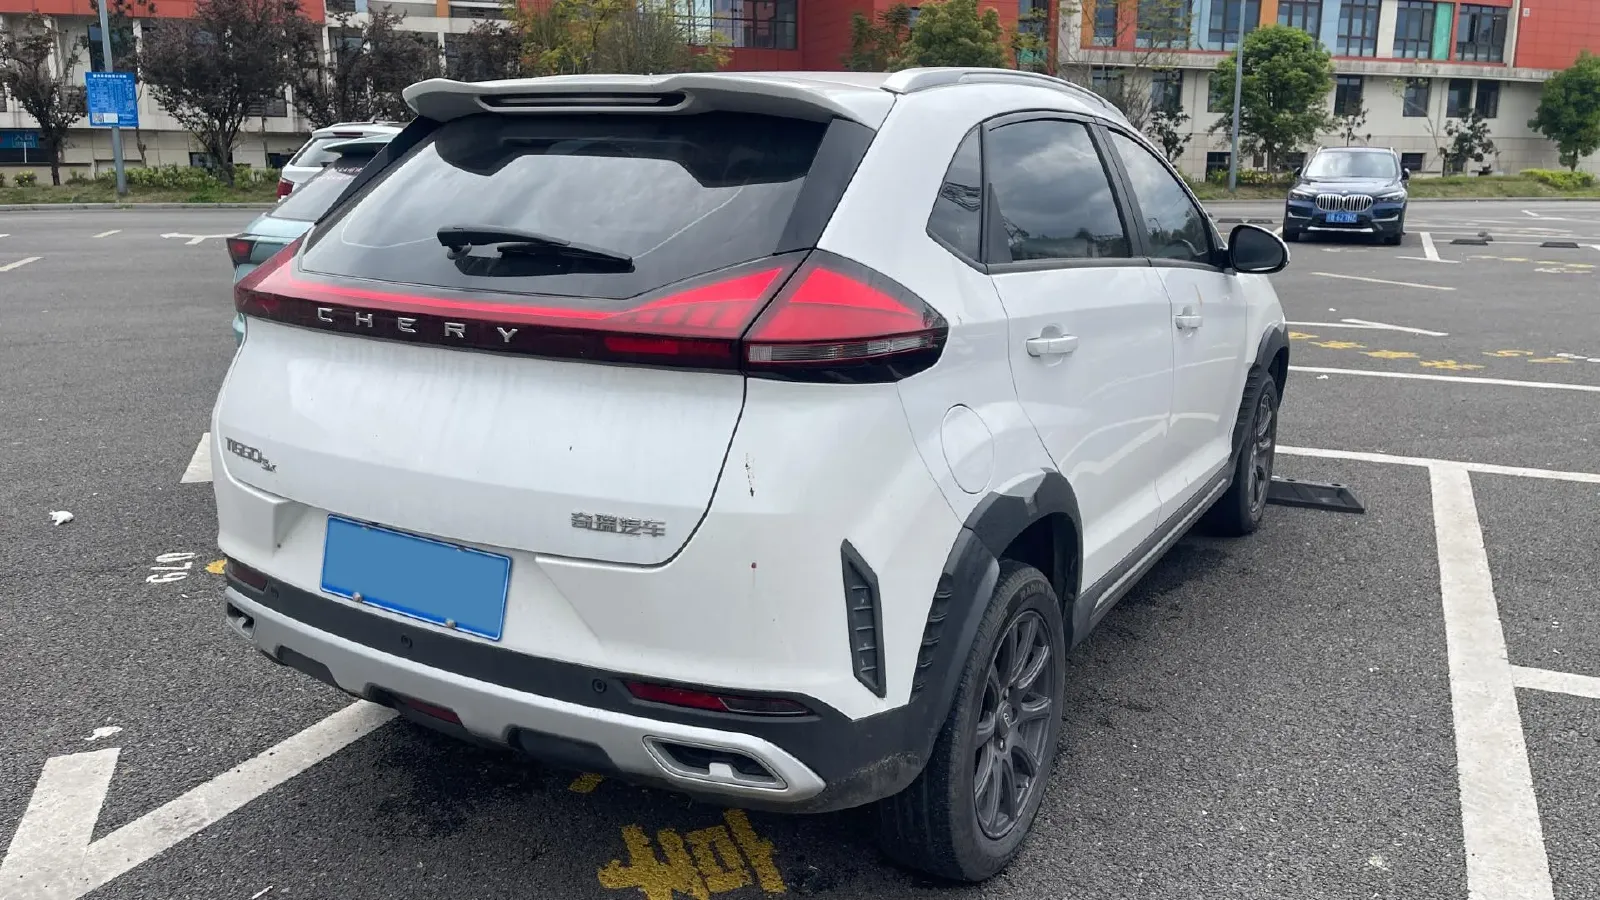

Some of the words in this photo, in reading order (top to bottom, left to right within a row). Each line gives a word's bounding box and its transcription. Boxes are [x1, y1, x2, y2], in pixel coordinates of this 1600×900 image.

[317, 306, 518, 343] CHERY
[225, 436, 263, 463] TIGGO
[571, 512, 666, 537] 奇瑞汽车
